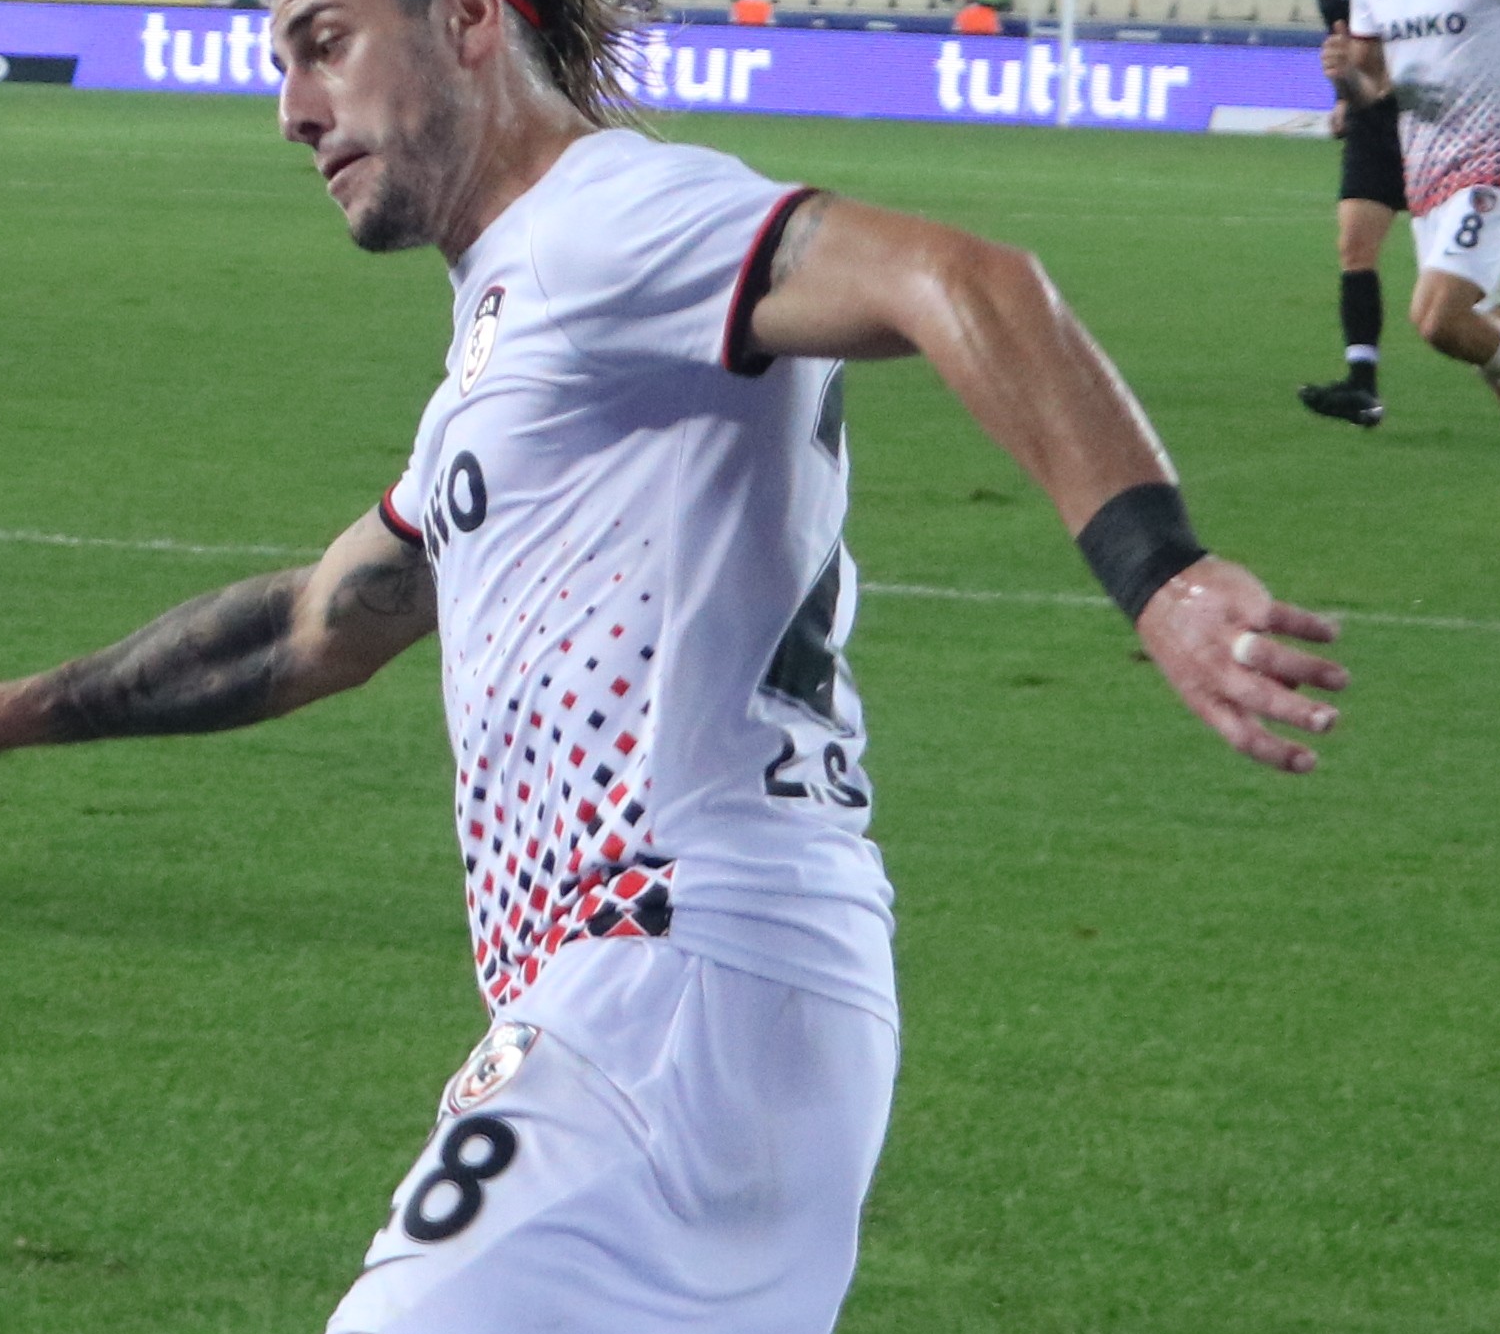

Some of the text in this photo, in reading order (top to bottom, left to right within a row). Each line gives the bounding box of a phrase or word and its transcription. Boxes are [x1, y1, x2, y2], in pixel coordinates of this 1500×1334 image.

[140, 12, 284, 83] tutt
[935, 40, 1189, 122] tuttur
[1455, 213, 1483, 248] 8
[403, 1115, 519, 1244] 8
